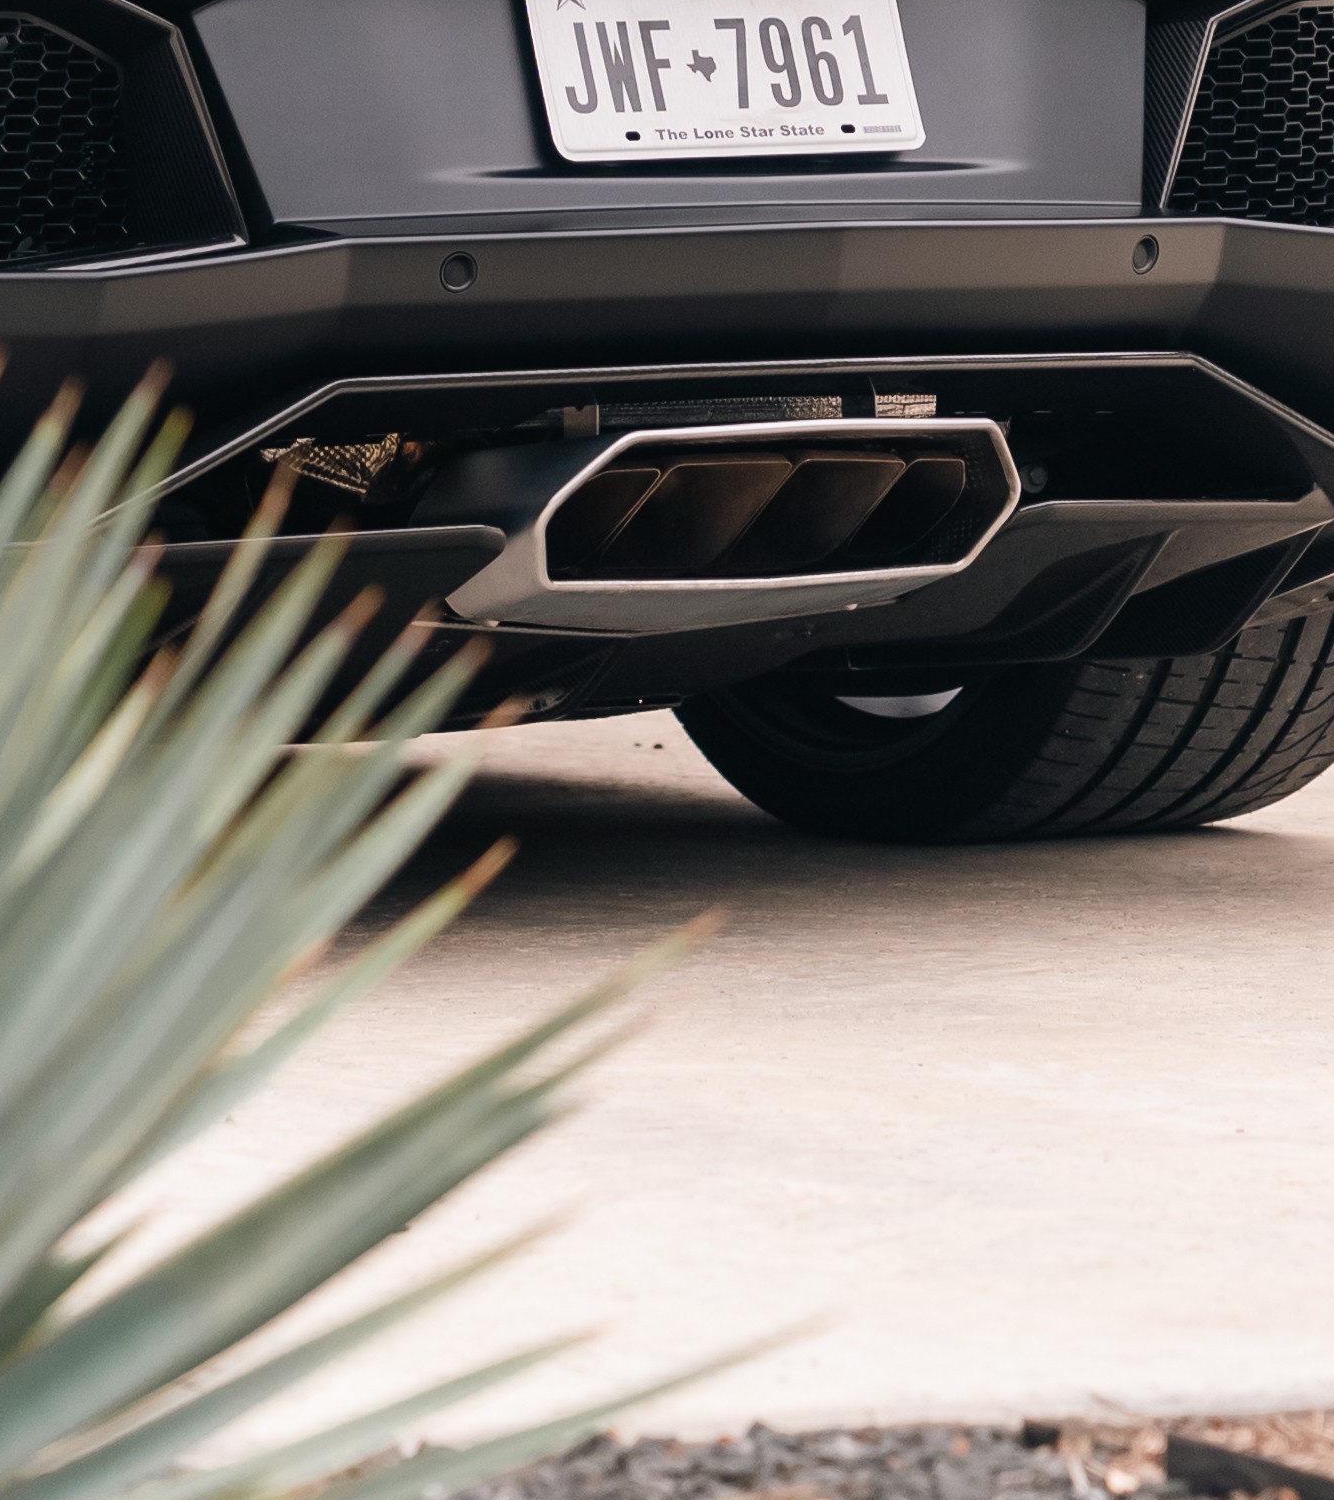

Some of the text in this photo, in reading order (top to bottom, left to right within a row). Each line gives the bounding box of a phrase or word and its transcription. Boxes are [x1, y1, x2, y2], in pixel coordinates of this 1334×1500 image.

[565, 14, 889, 115] JWF 7961
[655, 123, 825, 141] The Lone Star State
